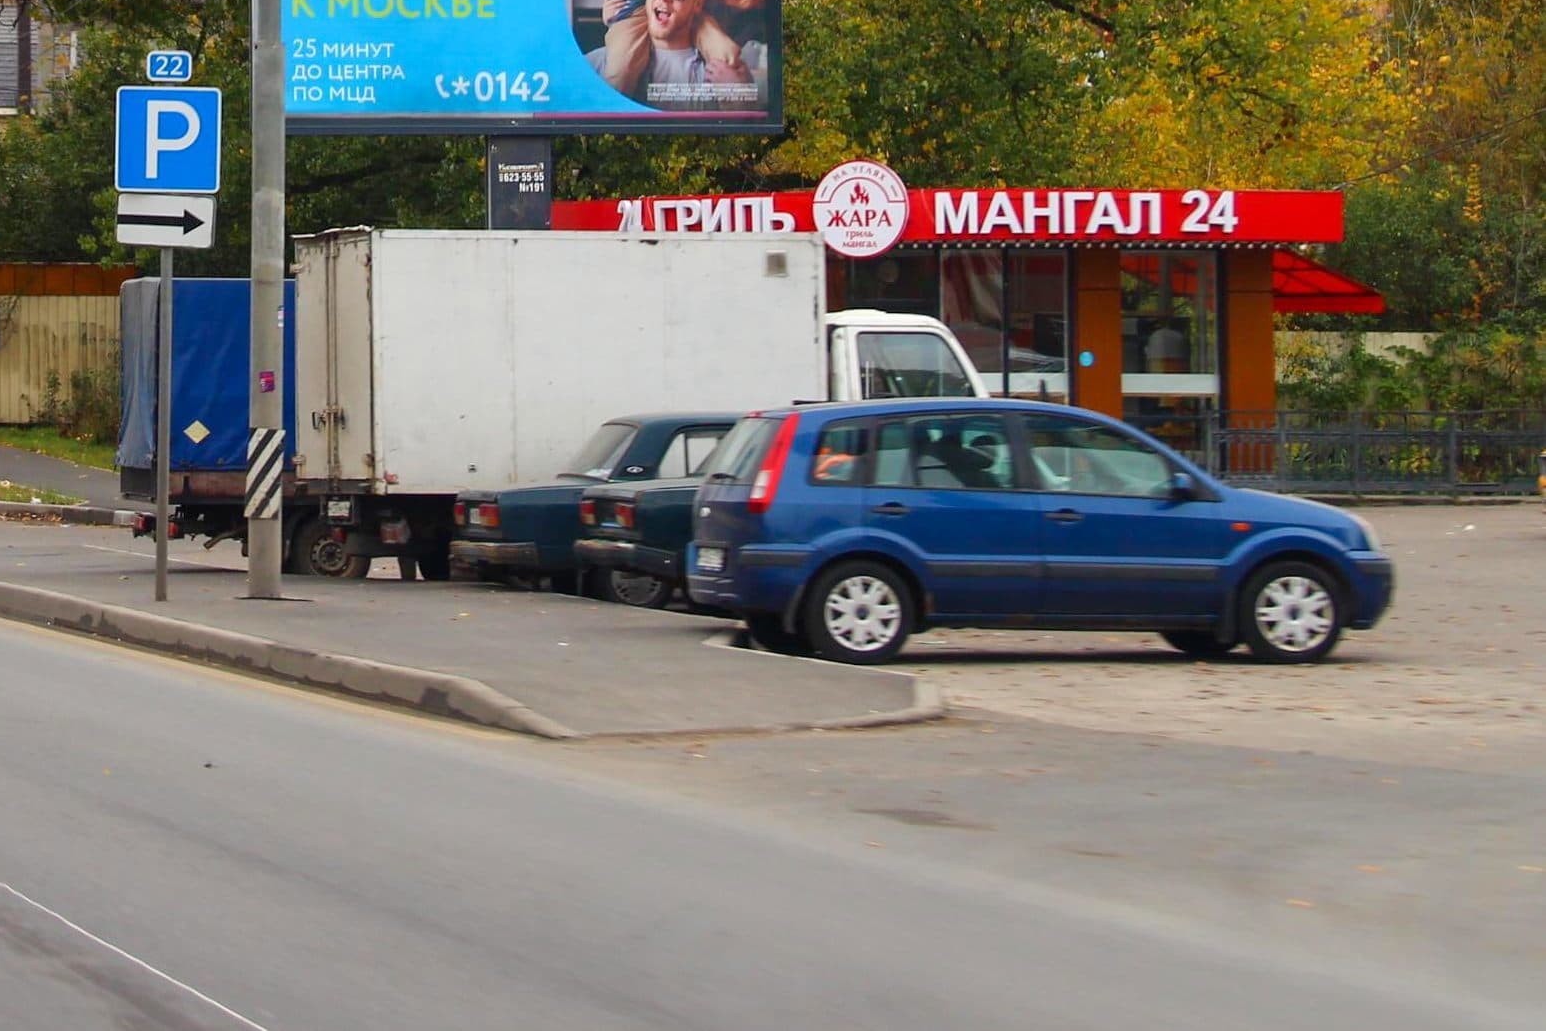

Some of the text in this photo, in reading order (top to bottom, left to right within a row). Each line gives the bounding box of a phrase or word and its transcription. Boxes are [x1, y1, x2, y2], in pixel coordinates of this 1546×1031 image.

[292, 38, 395, 58] 25 МИНУТ
[155, 55, 183, 76] 22
[292, 64, 405, 82] ДО ЦЕНТРА
[292, 85, 376, 104] ПО МЦД
[145, 100, 201, 179] P
[827, 209, 892, 227] ЖАРА
[934, 189, 1239, 235] МАНГАЛ 24
[845, 230, 874, 239] гриль
[842, 240, 878, 249] мангал
